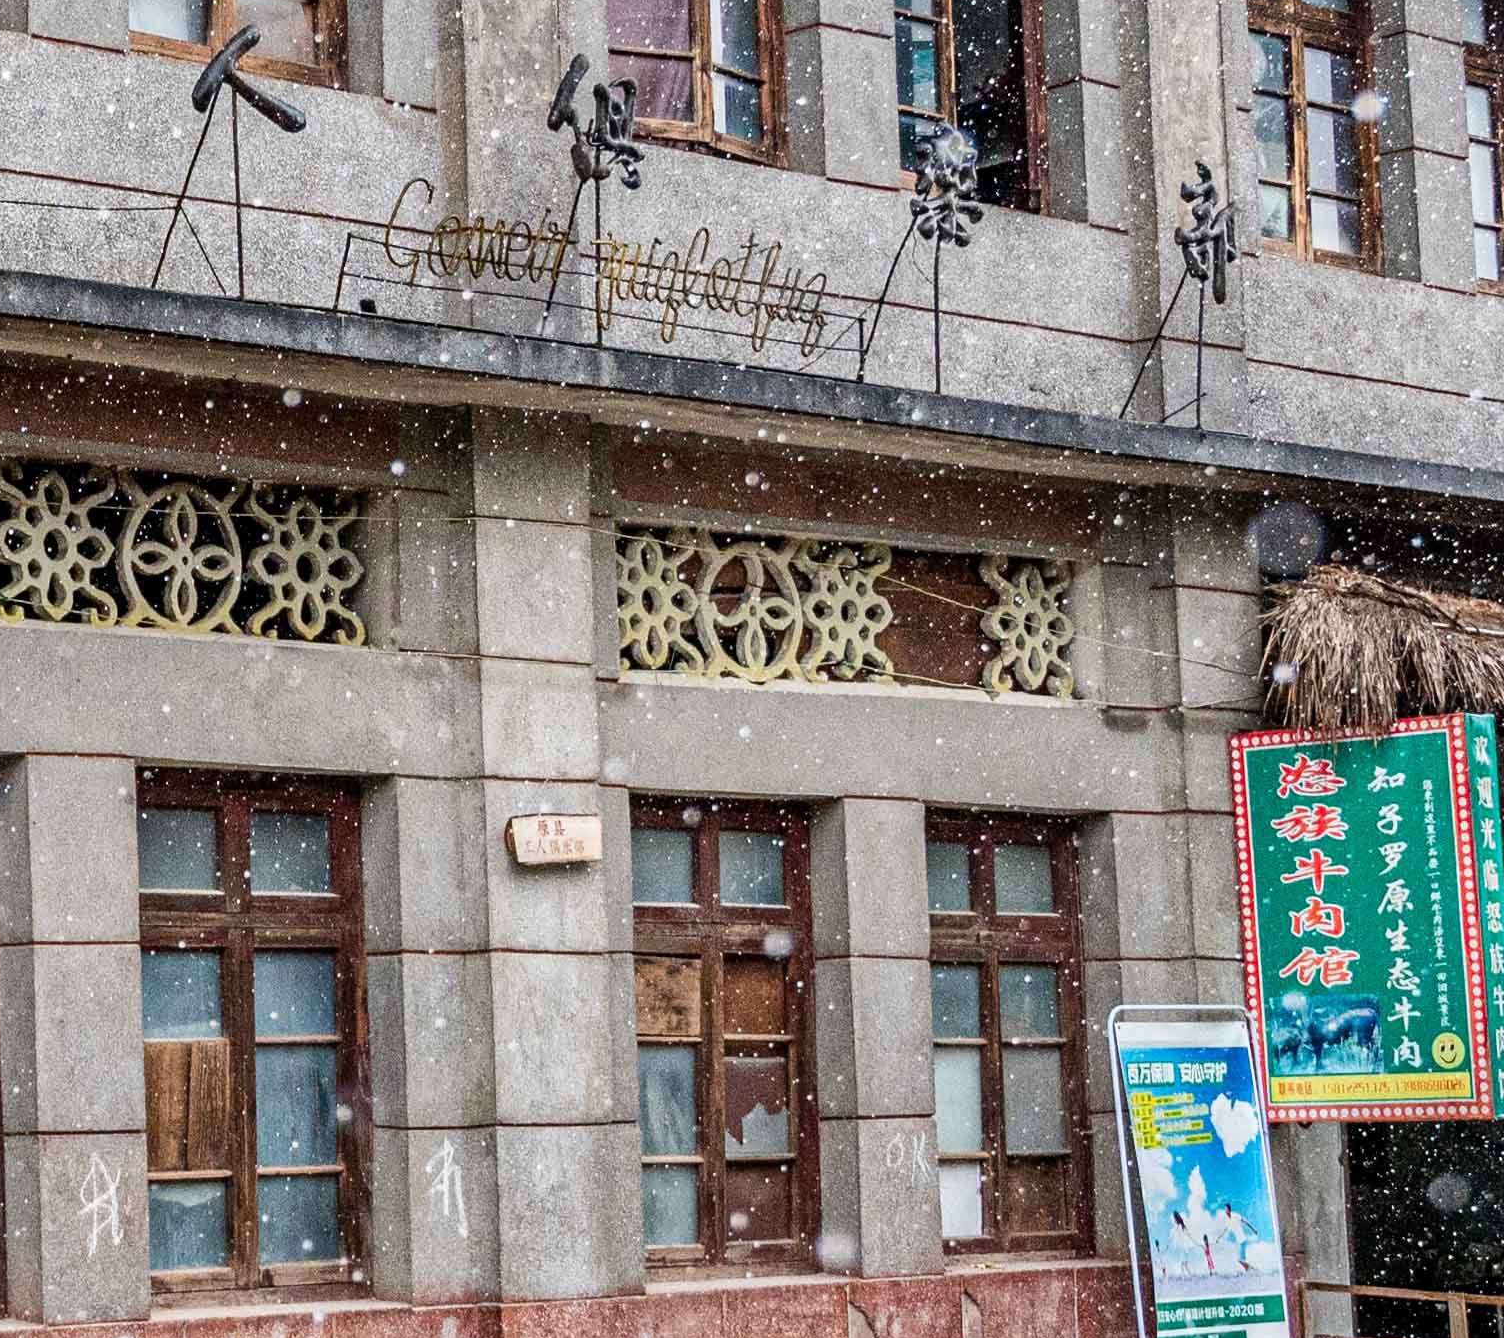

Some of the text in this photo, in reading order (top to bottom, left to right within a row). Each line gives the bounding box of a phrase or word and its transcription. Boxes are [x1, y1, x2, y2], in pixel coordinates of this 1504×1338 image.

[1271, 753, 1360, 988] 怒族牛肉馆
[1367, 766, 1423, 1068] 知子罗原生态牛肉
